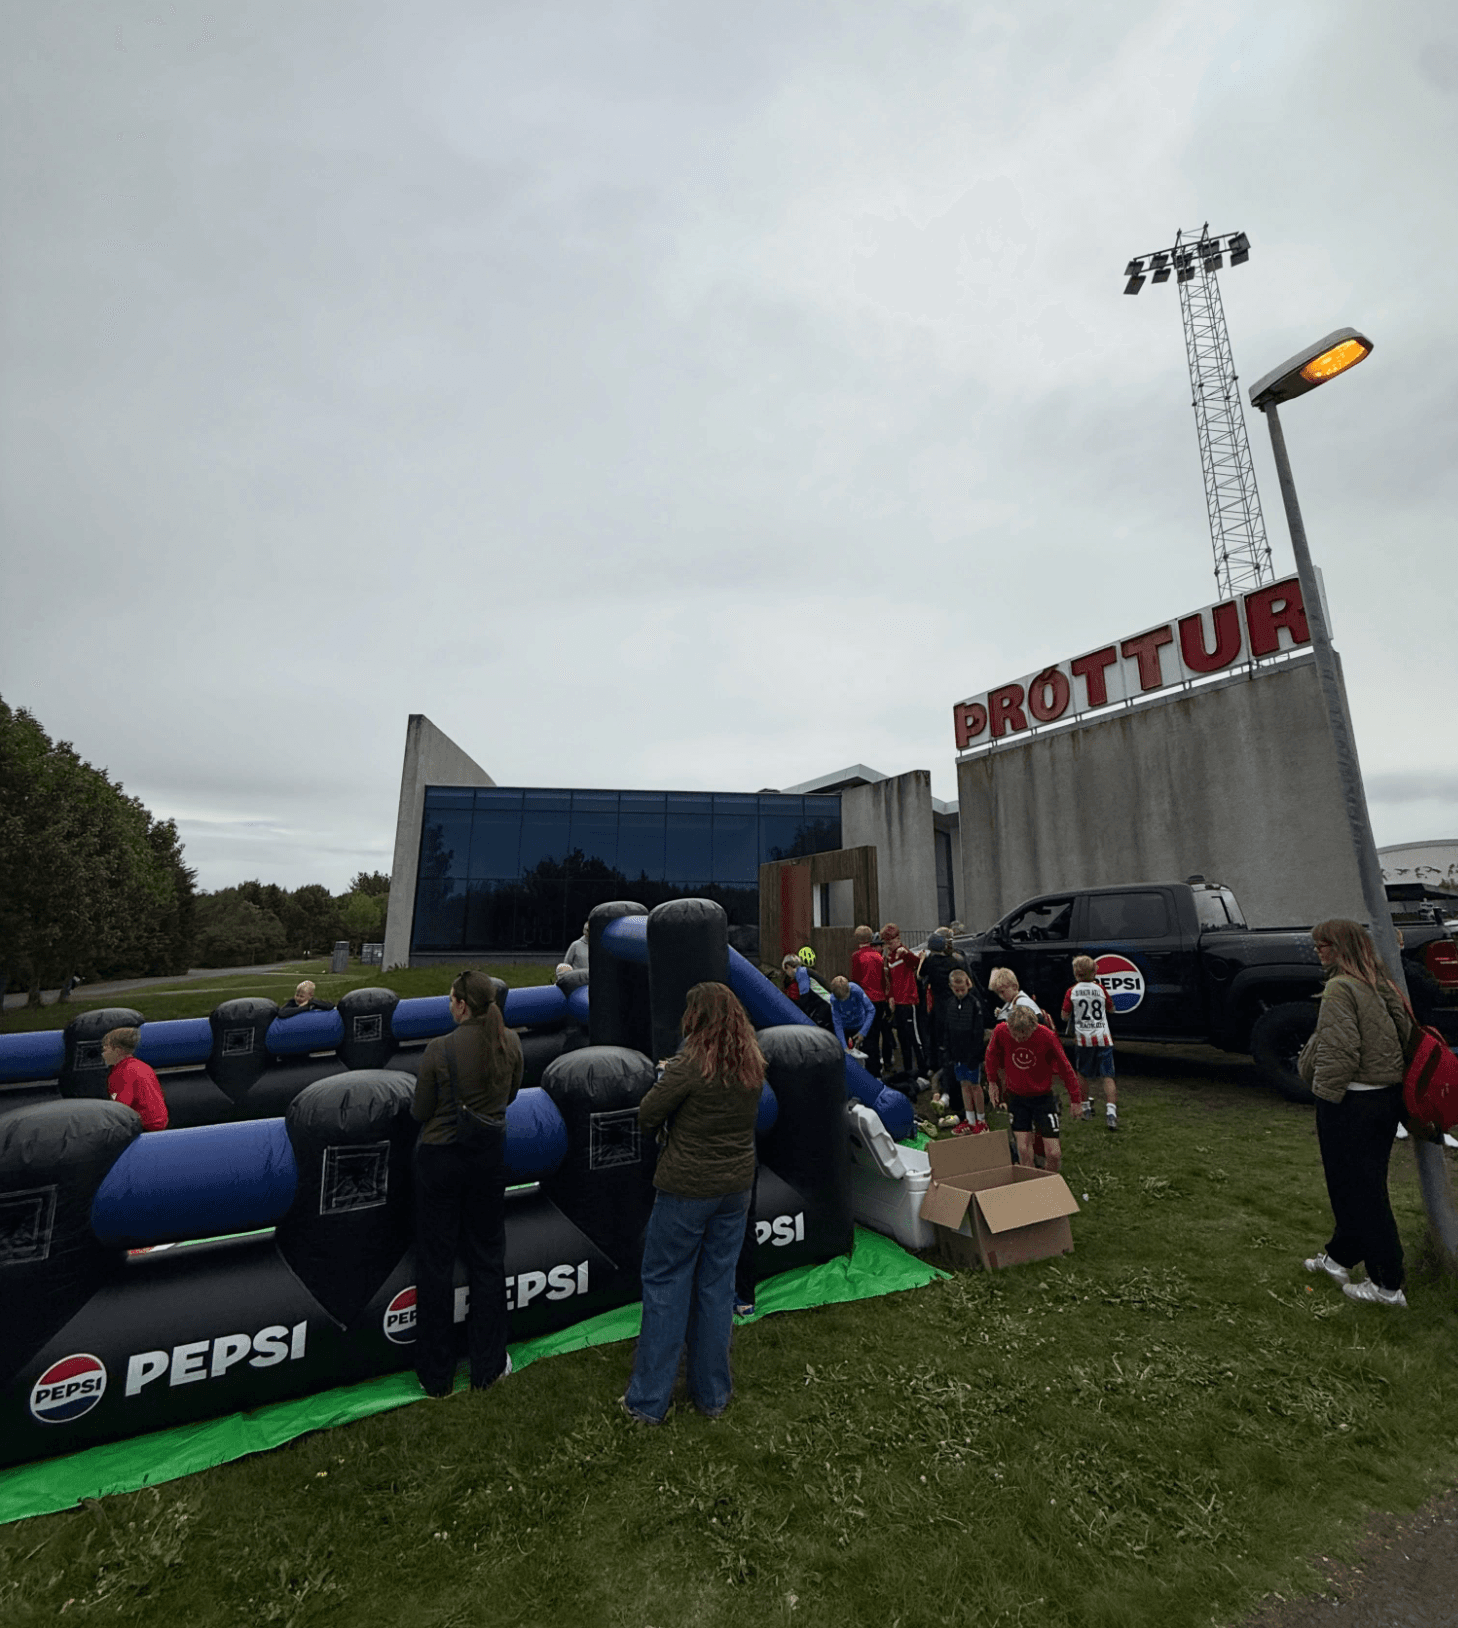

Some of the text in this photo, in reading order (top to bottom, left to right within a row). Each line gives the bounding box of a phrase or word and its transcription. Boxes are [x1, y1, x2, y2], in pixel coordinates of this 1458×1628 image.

[953, 577, 1311, 750] ÞRÓTTUR
[1096, 977, 1141, 990] EPSI
[1079, 999, 1103, 1021] 28
[754, 1211, 805, 1247] PSI
[387, 1311, 417, 1328] PEP
[124, 1320, 308, 1397] PEPSI
[35, 1376, 103, 1405] PEPSI
